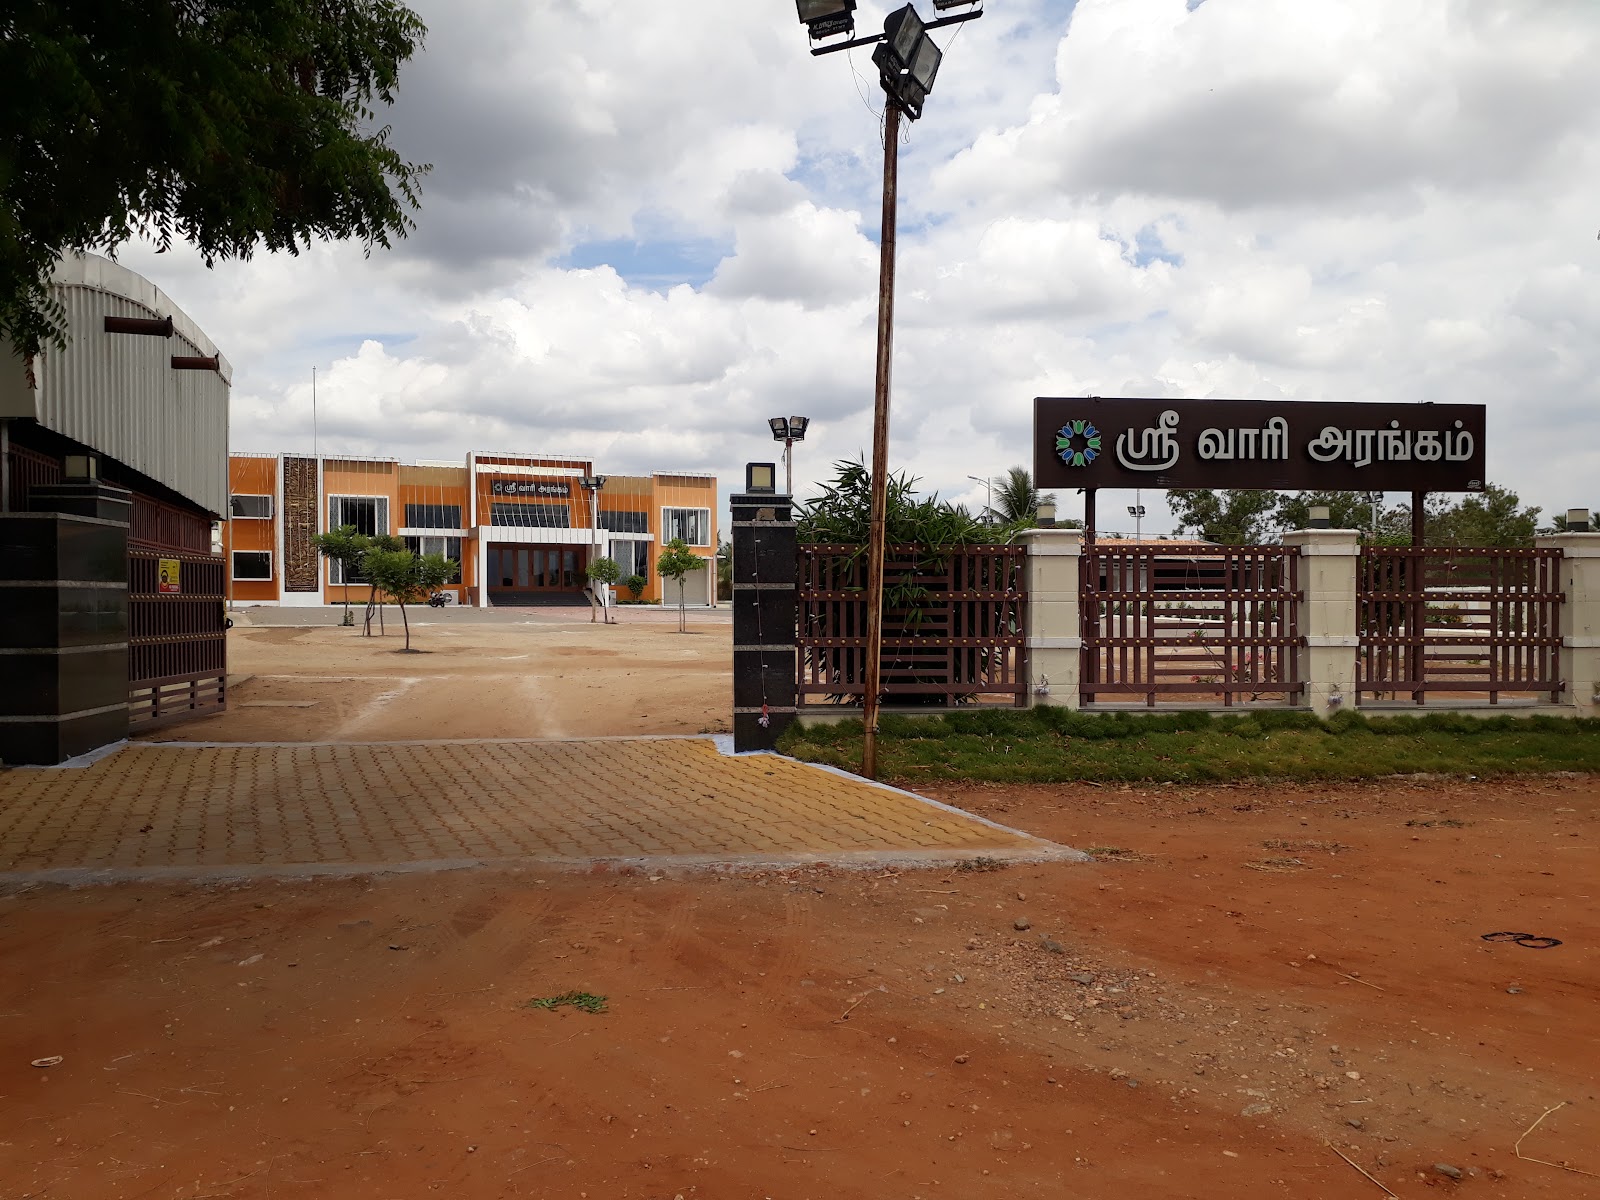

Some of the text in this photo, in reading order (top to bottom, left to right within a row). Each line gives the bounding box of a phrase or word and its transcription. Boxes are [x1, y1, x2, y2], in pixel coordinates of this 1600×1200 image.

[1115, 410, 1475, 471] ஸ்ரீ வாரி அரங்கம்
[518, 483, 536, 492] வாரி
[538, 484, 569, 493] அரங்கம்
